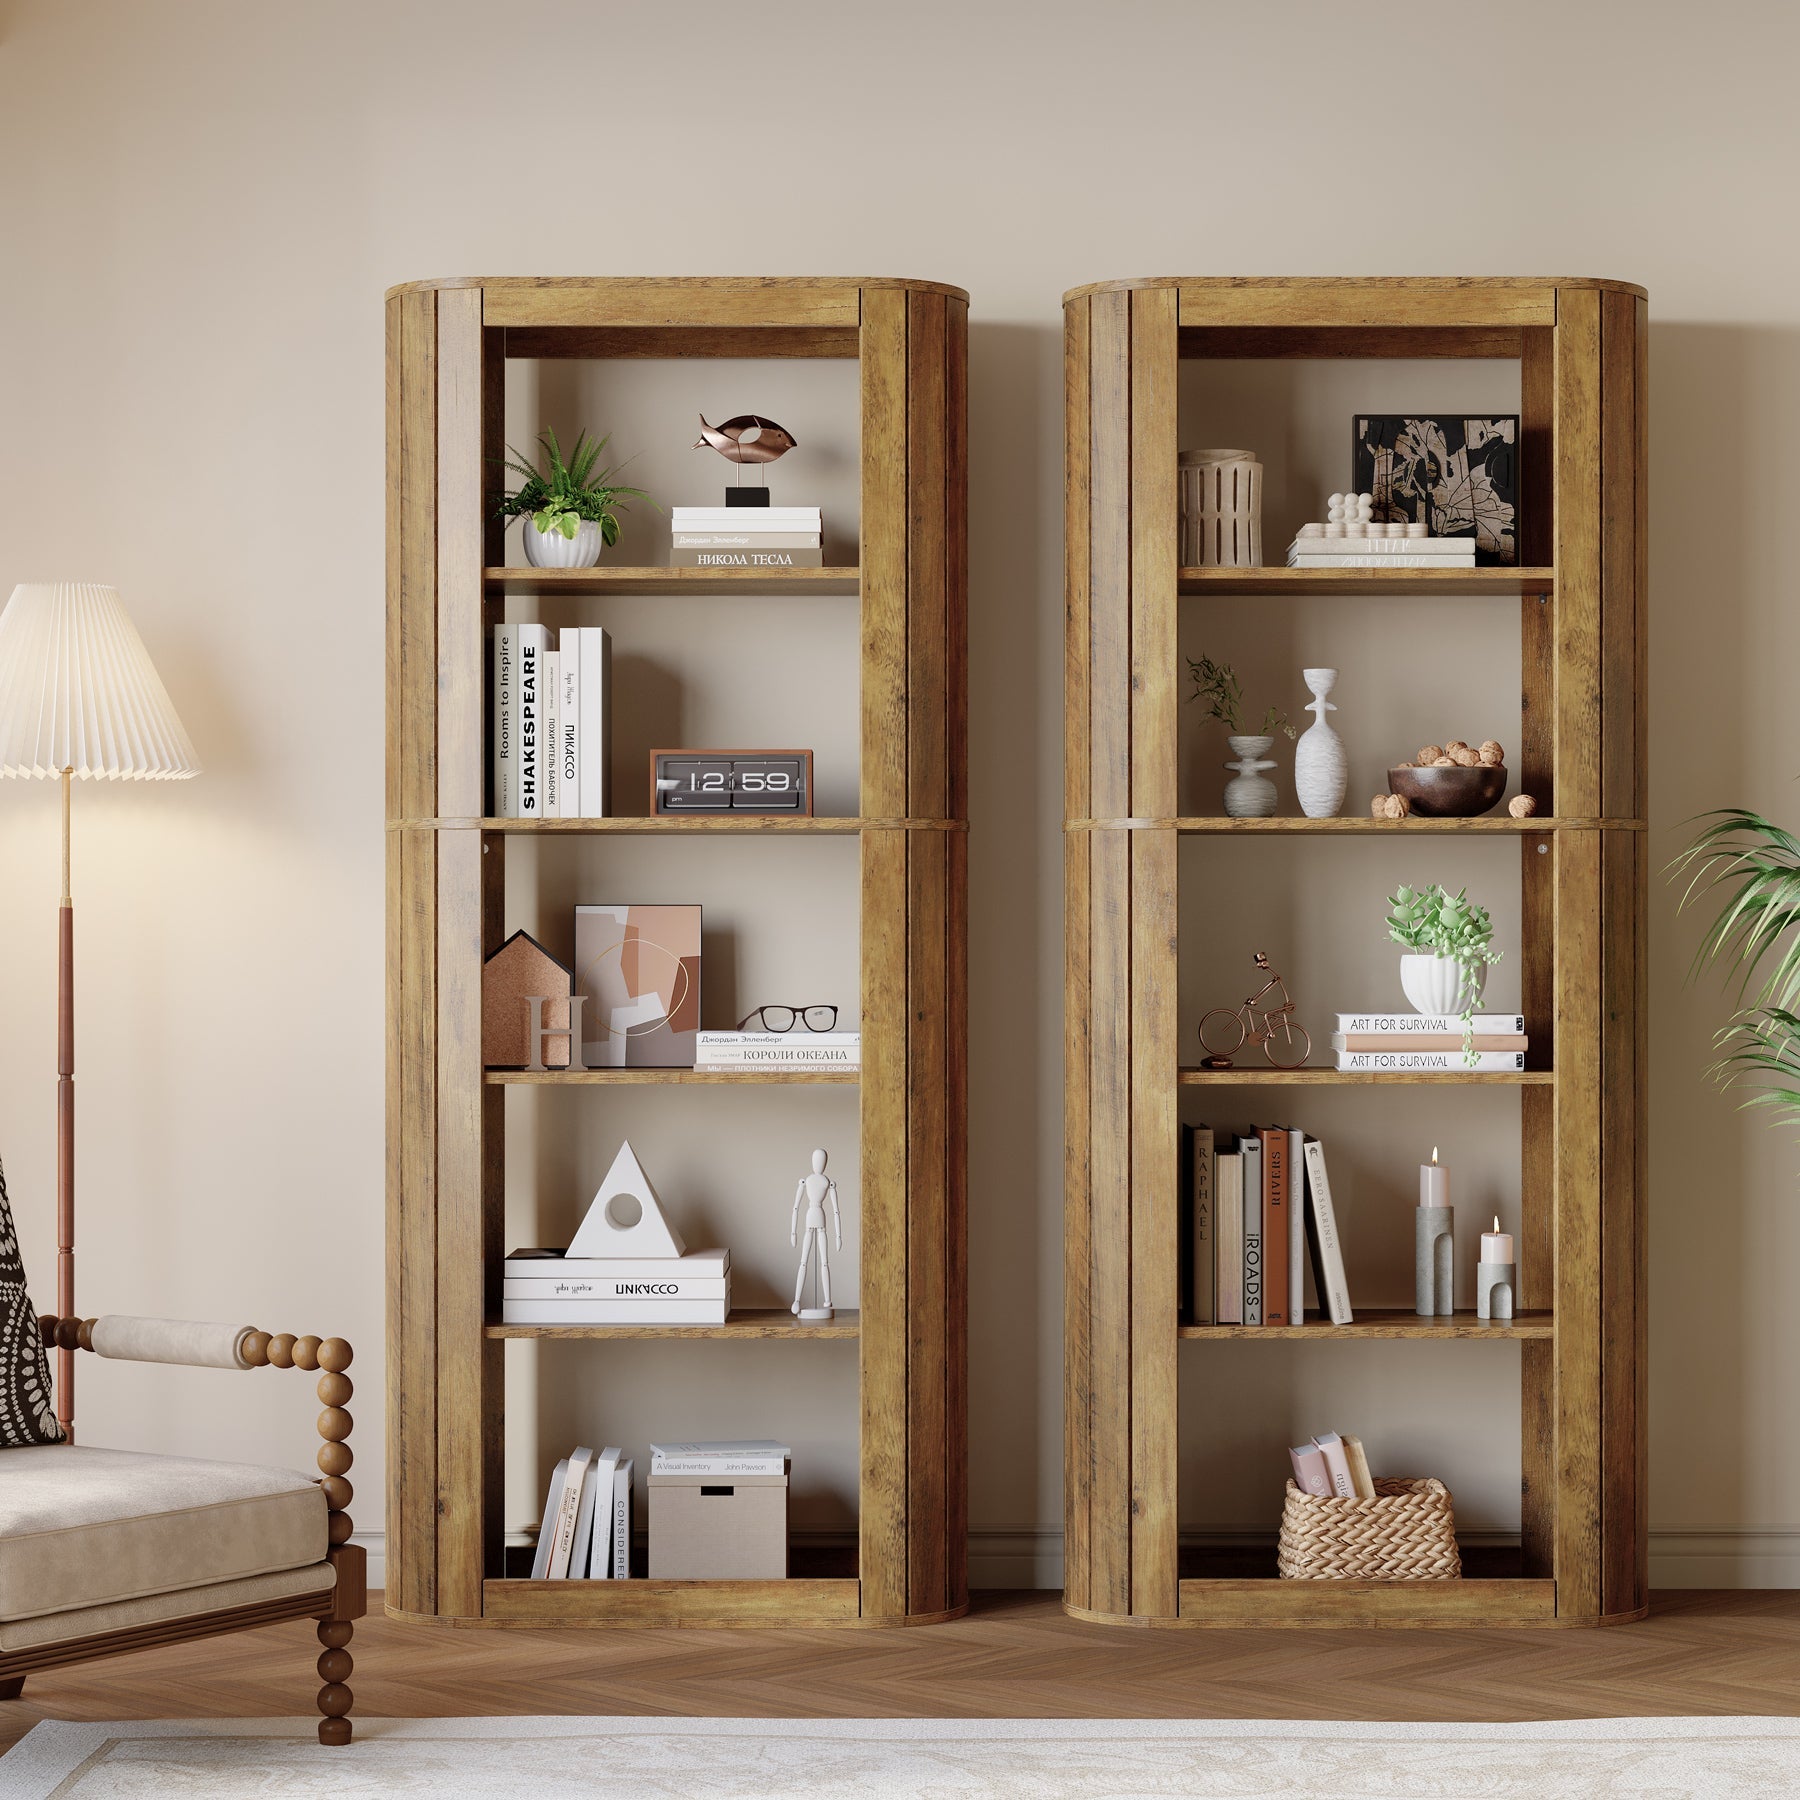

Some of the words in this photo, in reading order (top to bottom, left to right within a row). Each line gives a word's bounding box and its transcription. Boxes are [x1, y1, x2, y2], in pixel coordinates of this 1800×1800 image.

[697, 554, 748, 565] НИКОЛА
[751, 554, 793, 565] ТЕСЛА
[500, 636, 512, 686] Inspire
[501, 691, 509, 707] to
[500, 710, 509, 759] Rooms
[523, 646, 536, 810] SHAKESPEARE
[565, 725, 575, 780] ПИКАССО
[1350, 1018, 1370, 1031] ART
[1374, 1018, 1396, 1031] FOR
[1399, 1018, 1448, 1031] SURVIVAL
[701, 1035, 738, 1044] Джордан
[740, 1035, 783, 1044] Элленберг
[743, 1050, 794, 1060] КОРОЛИ
[796, 1050, 848, 1060] ОКЕАНА
[1350, 1055, 1370, 1067] ART
[1374, 1055, 1396, 1067] FOR
[1399, 1055, 1448, 1067] SURVIVAL
[1271, 1151, 1281, 1206] RIVERS
[1199, 1147, 1208, 1241] RAPHAEL
[663, 1463, 682, 1471] Visual
[682, 1463, 711, 1472] Inventory
[724, 1463, 740, 1471] John
